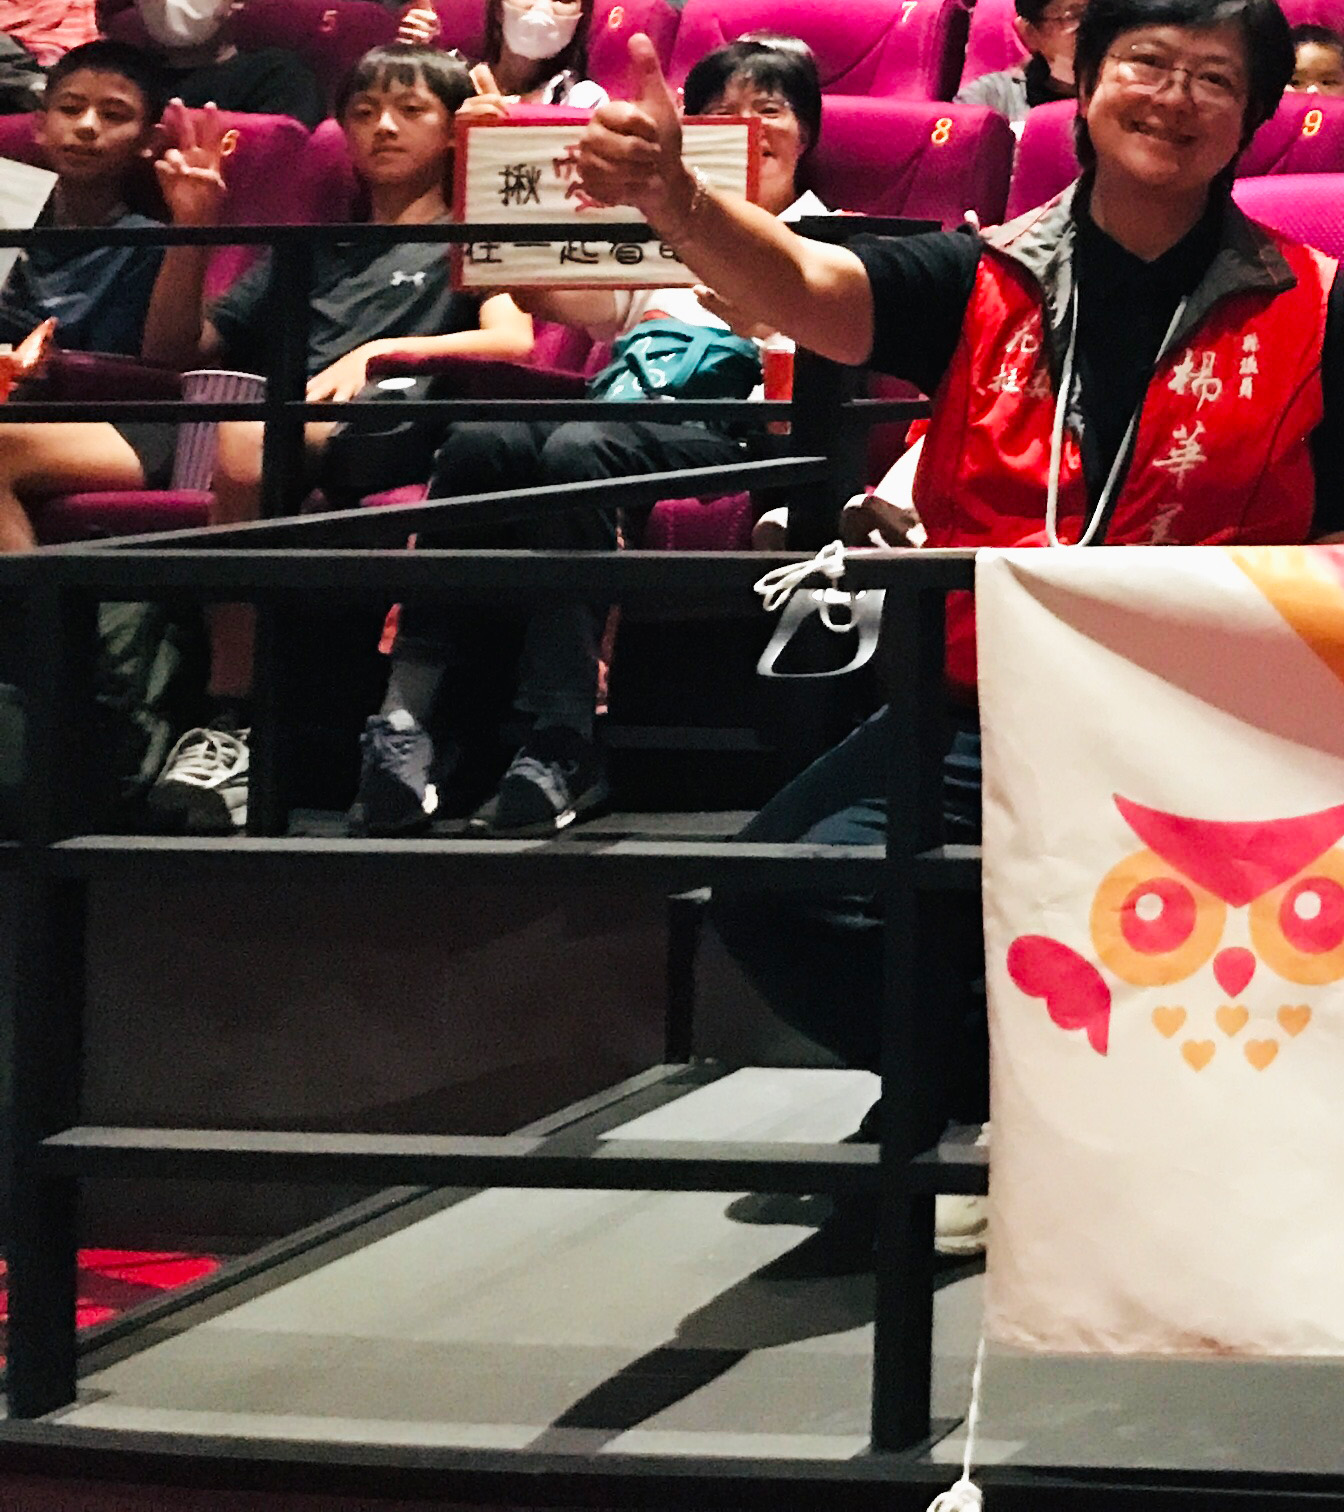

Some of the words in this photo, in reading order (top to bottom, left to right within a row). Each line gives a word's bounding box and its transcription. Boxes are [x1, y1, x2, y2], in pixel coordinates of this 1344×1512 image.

[320, 9, 336, 32] 5
[608, 6, 624, 29] 6
[901, 0, 917, 22] 7
[931, 117, 953, 143] 8
[1302, 109, 1323, 136] 9
[221, 128, 238, 155] 6
